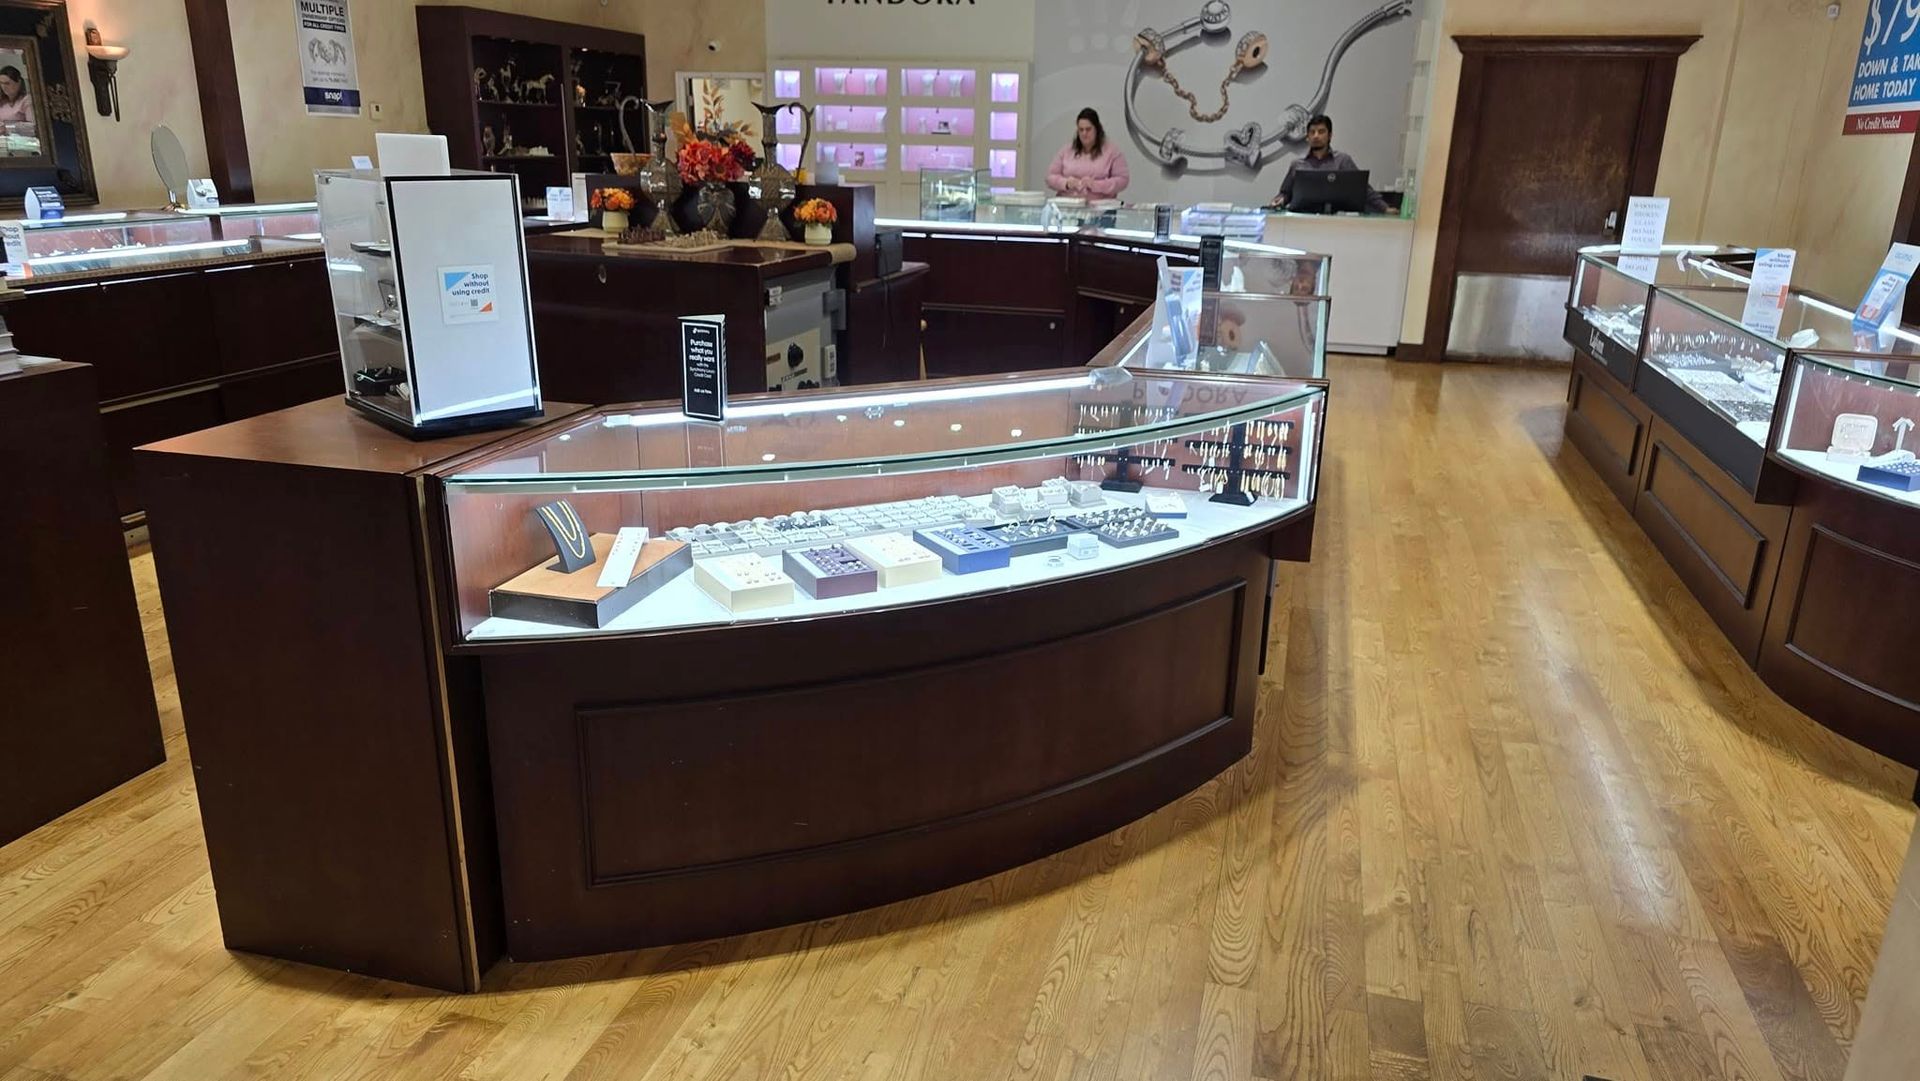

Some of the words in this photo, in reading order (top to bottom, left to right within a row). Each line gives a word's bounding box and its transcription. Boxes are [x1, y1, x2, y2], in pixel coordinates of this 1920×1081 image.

[300, 1, 345, 17] MULTIPLE
[1858, 58, 1889, 77] DOWN
[1890, 56, 1899, 74] &
[1853, 82, 1881, 101] HOME
[1882, 78, 1917, 98] TODAY
[1856, 117, 1864, 130] No
[1864, 117, 1881, 130] Credit
[1881, 114, 1902, 130] Needed
[471, 272, 489, 280] Shop
[463, 280, 490, 288] without
[690, 339, 712, 347] Purchase
[689, 354, 703, 362] really
